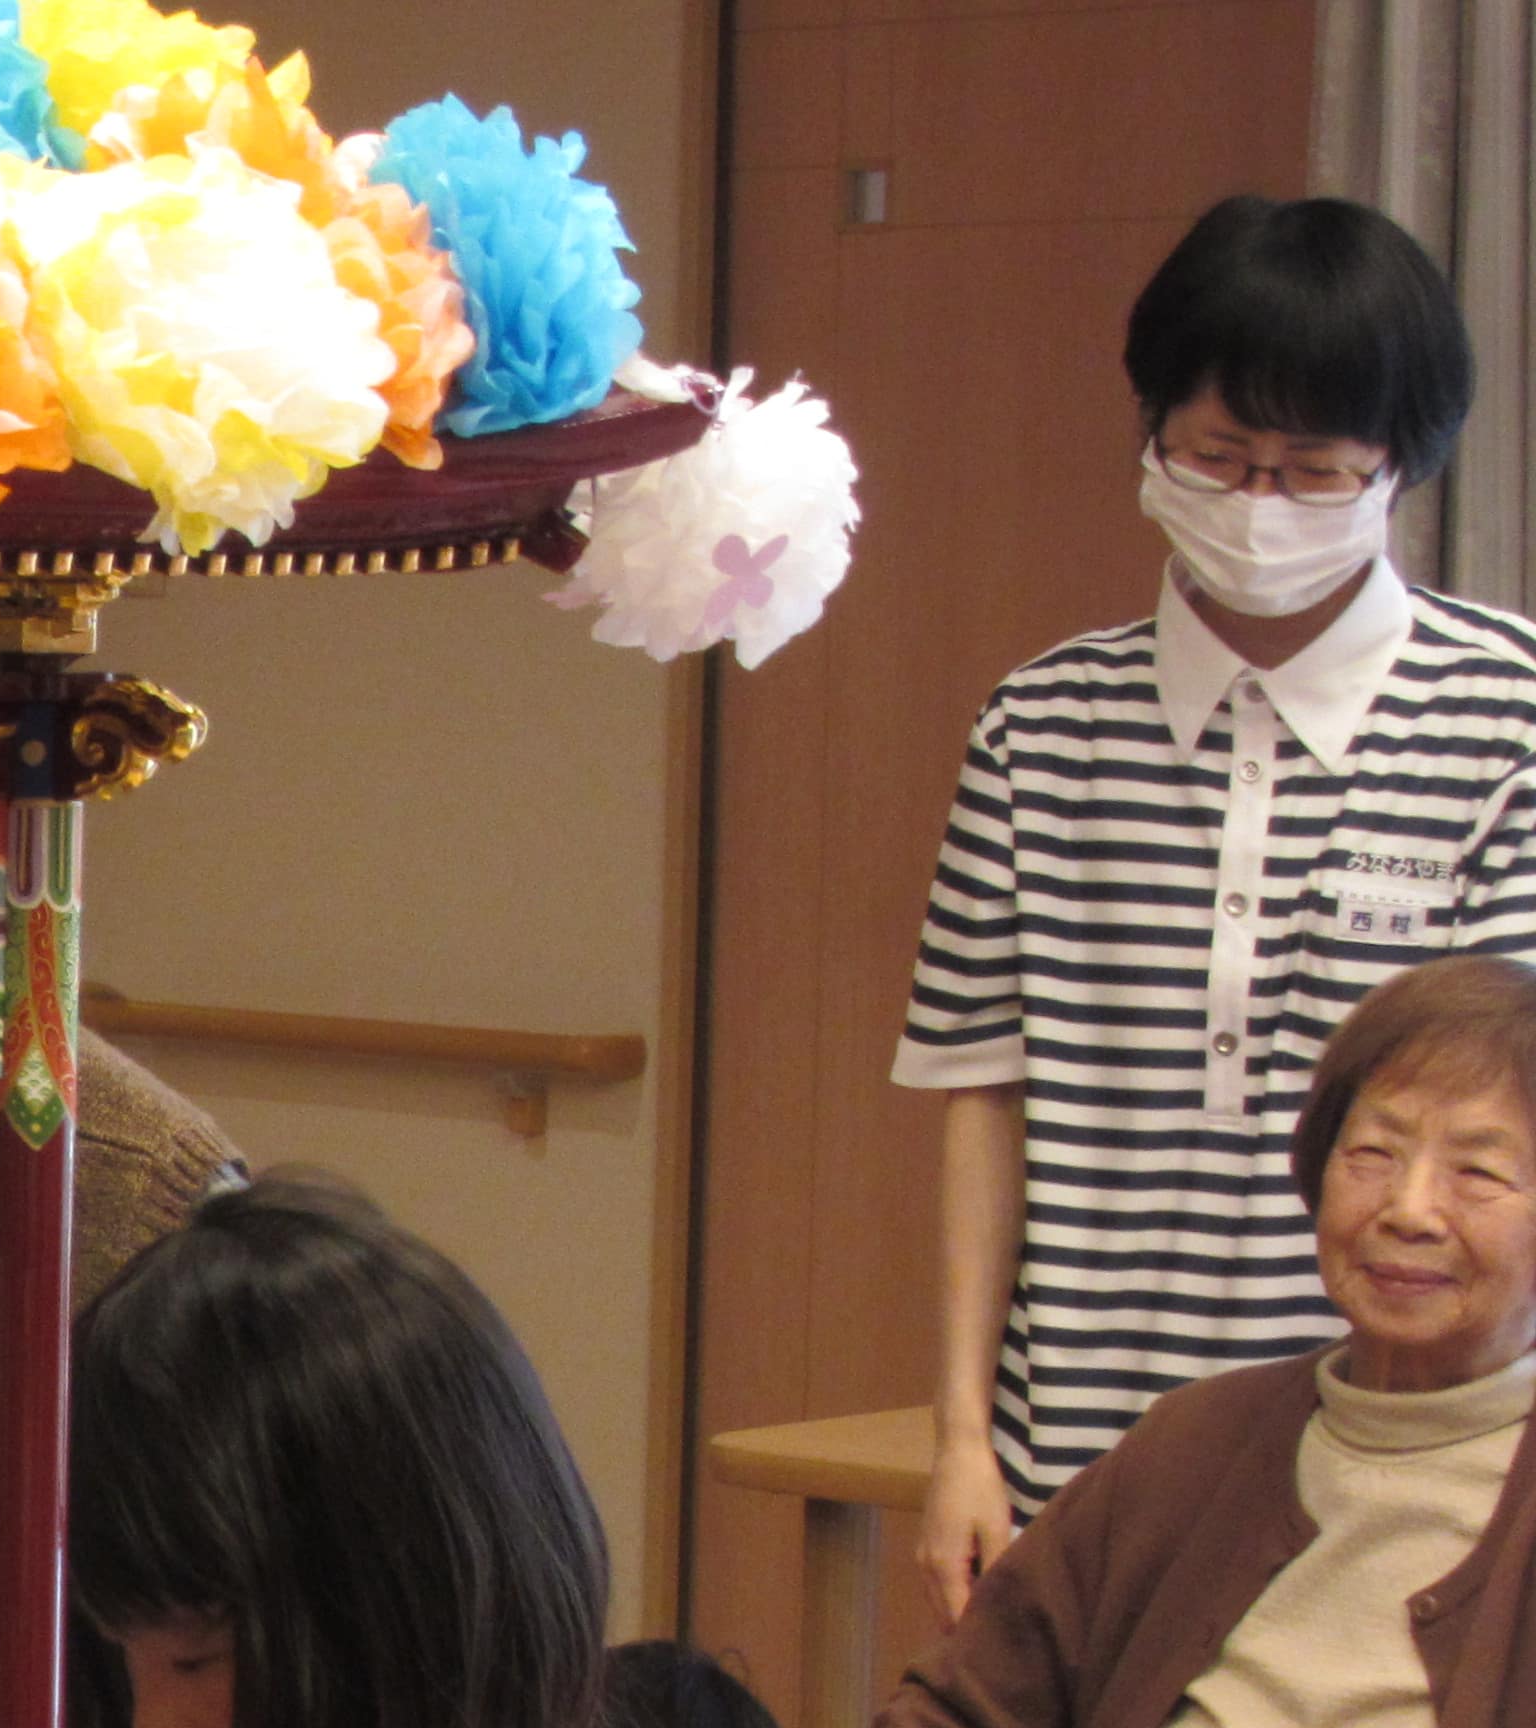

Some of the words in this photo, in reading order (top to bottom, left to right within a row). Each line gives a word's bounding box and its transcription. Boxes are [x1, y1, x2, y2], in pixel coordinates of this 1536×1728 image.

[1345, 852, 1456, 882] みなみやま
